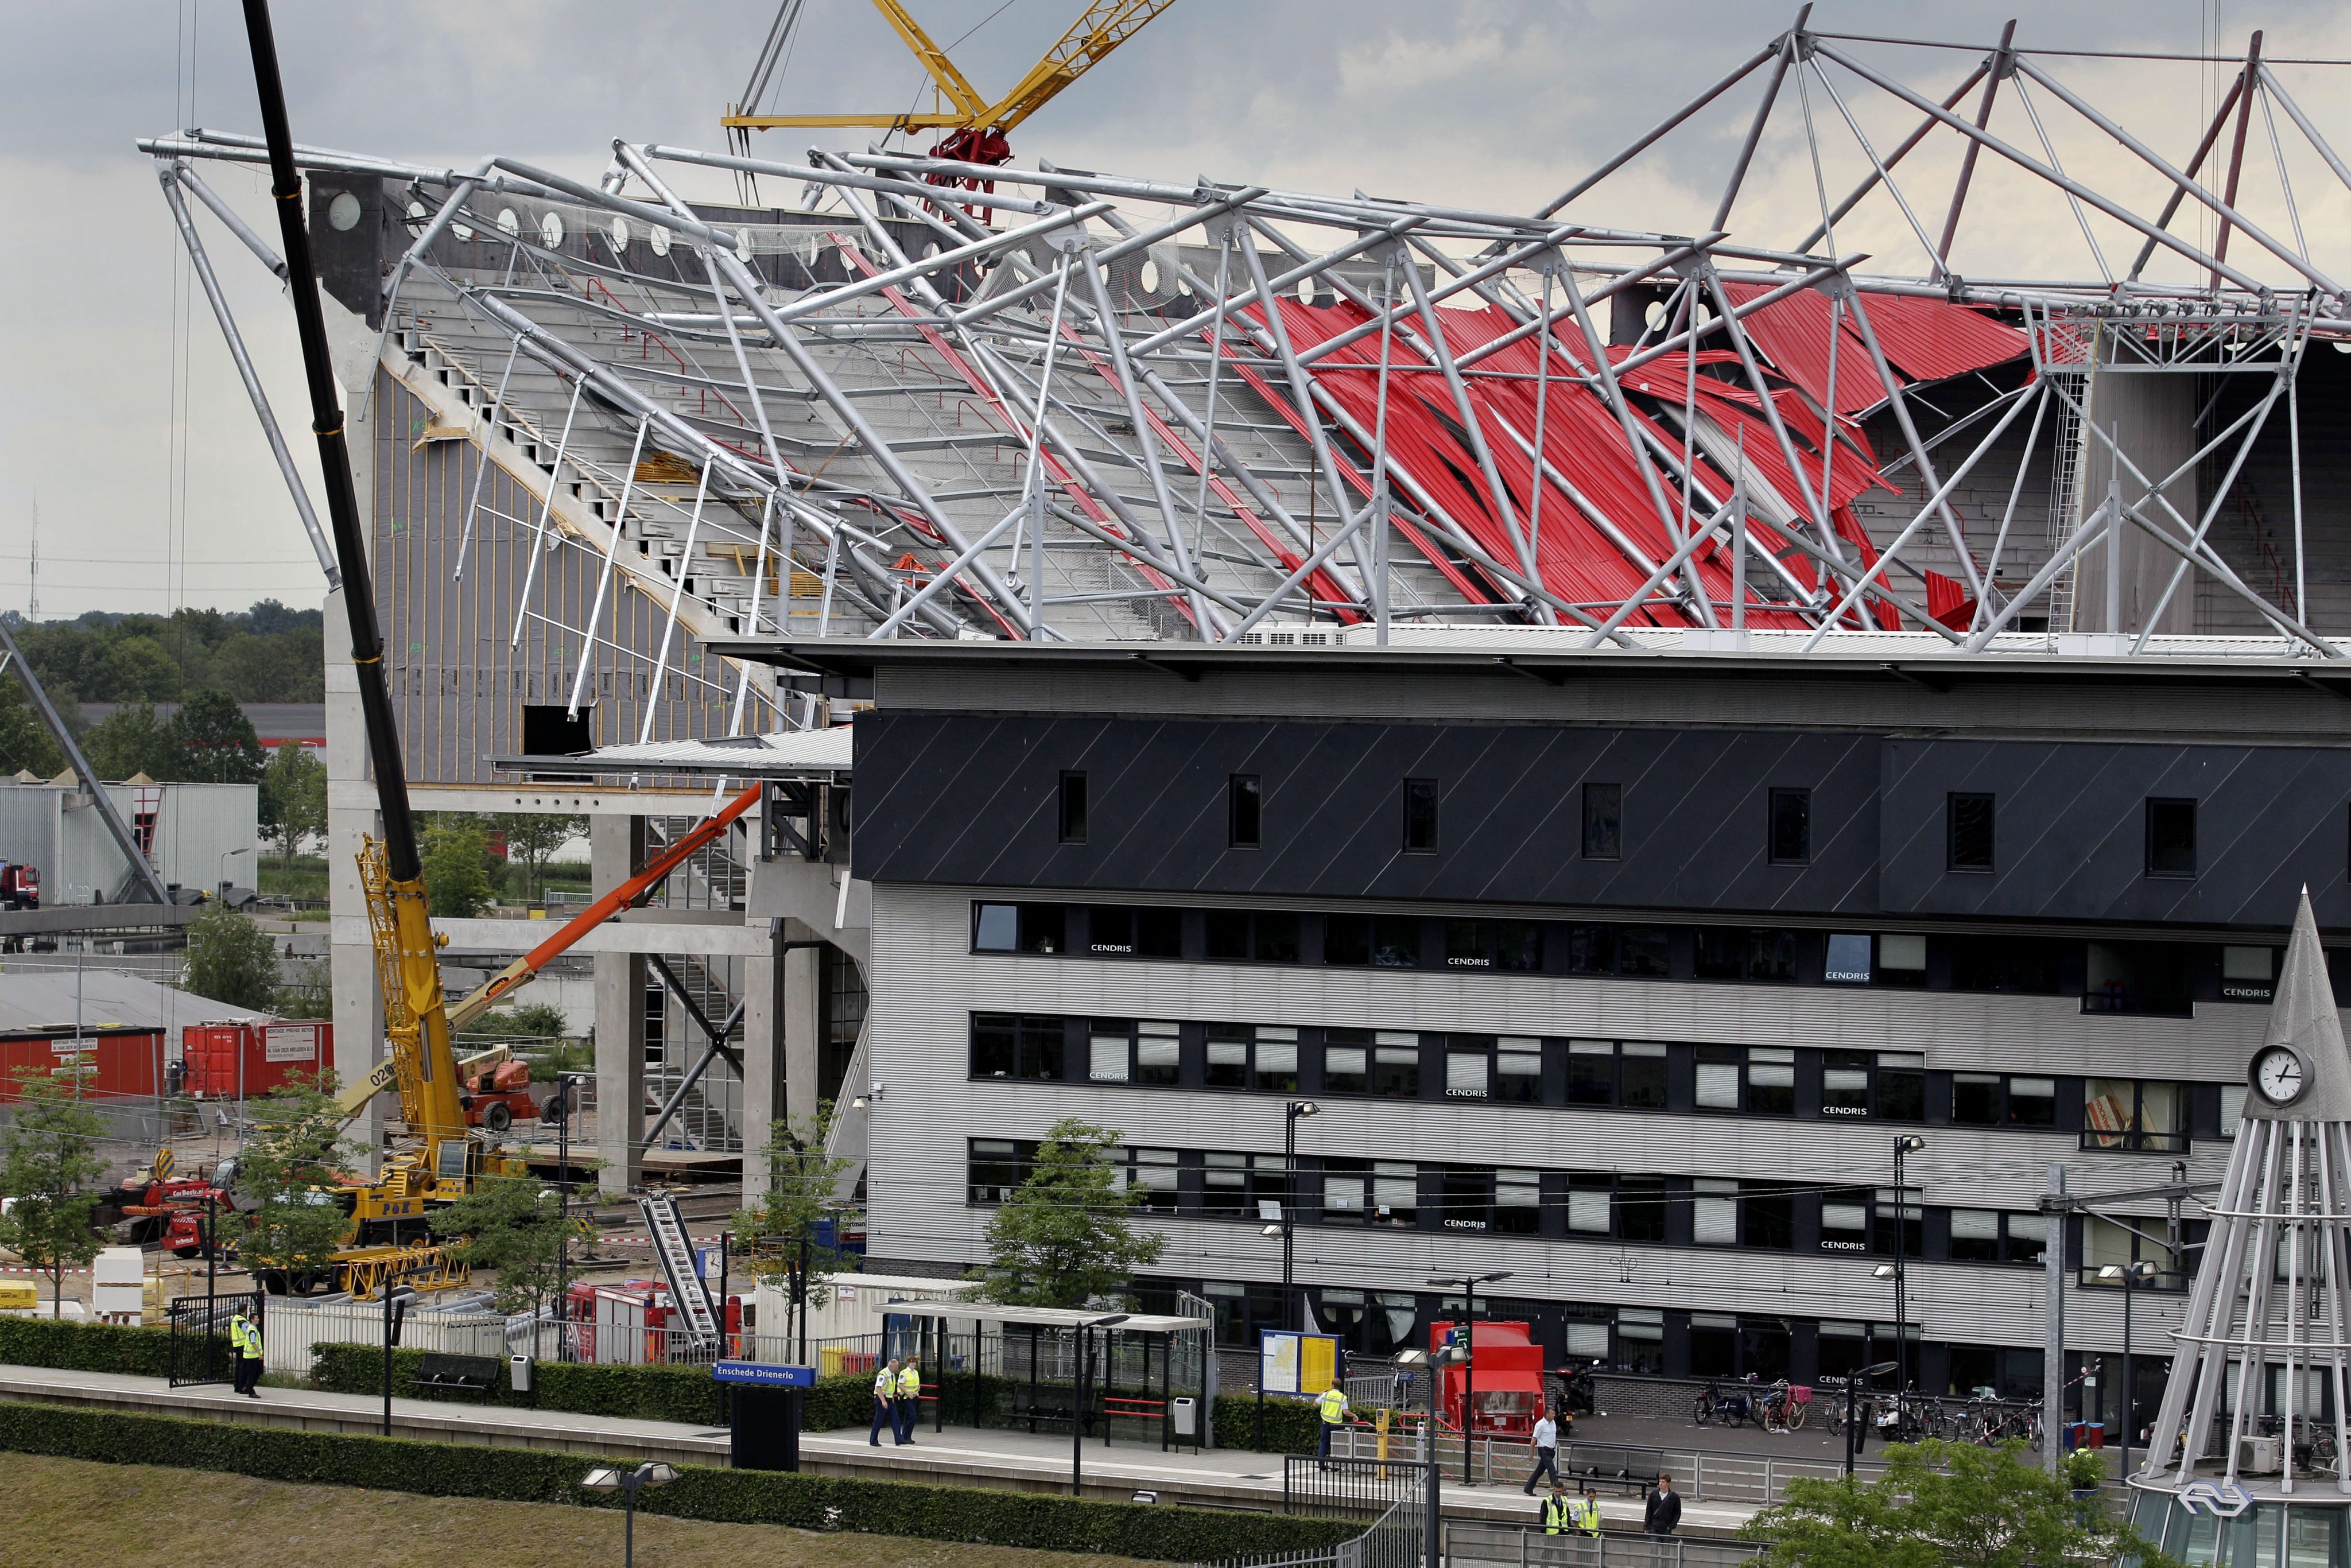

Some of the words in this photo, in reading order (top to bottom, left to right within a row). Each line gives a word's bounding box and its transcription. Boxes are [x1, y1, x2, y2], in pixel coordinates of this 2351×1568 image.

[1091, 944, 1131, 952] CENDRIS
[1448, 958, 1489, 966] CENDRIS
[1826, 972, 1869, 980] CENDRIS
[2224, 988, 2270, 996] CENDRIS
[1446, 1089, 1488, 1097] CENDRIS
[1823, 1107, 1867, 1115] CENDRIS
[1444, 1220, 1486, 1228] CENDRIS
[1821, 1241, 1865, 1250] CENDRIS
[718, 1367, 754, 1377] Enschede
[756, 1369, 794, 1379] Drienerlo
[1819, 1376, 1864, 1385] CENDIS
